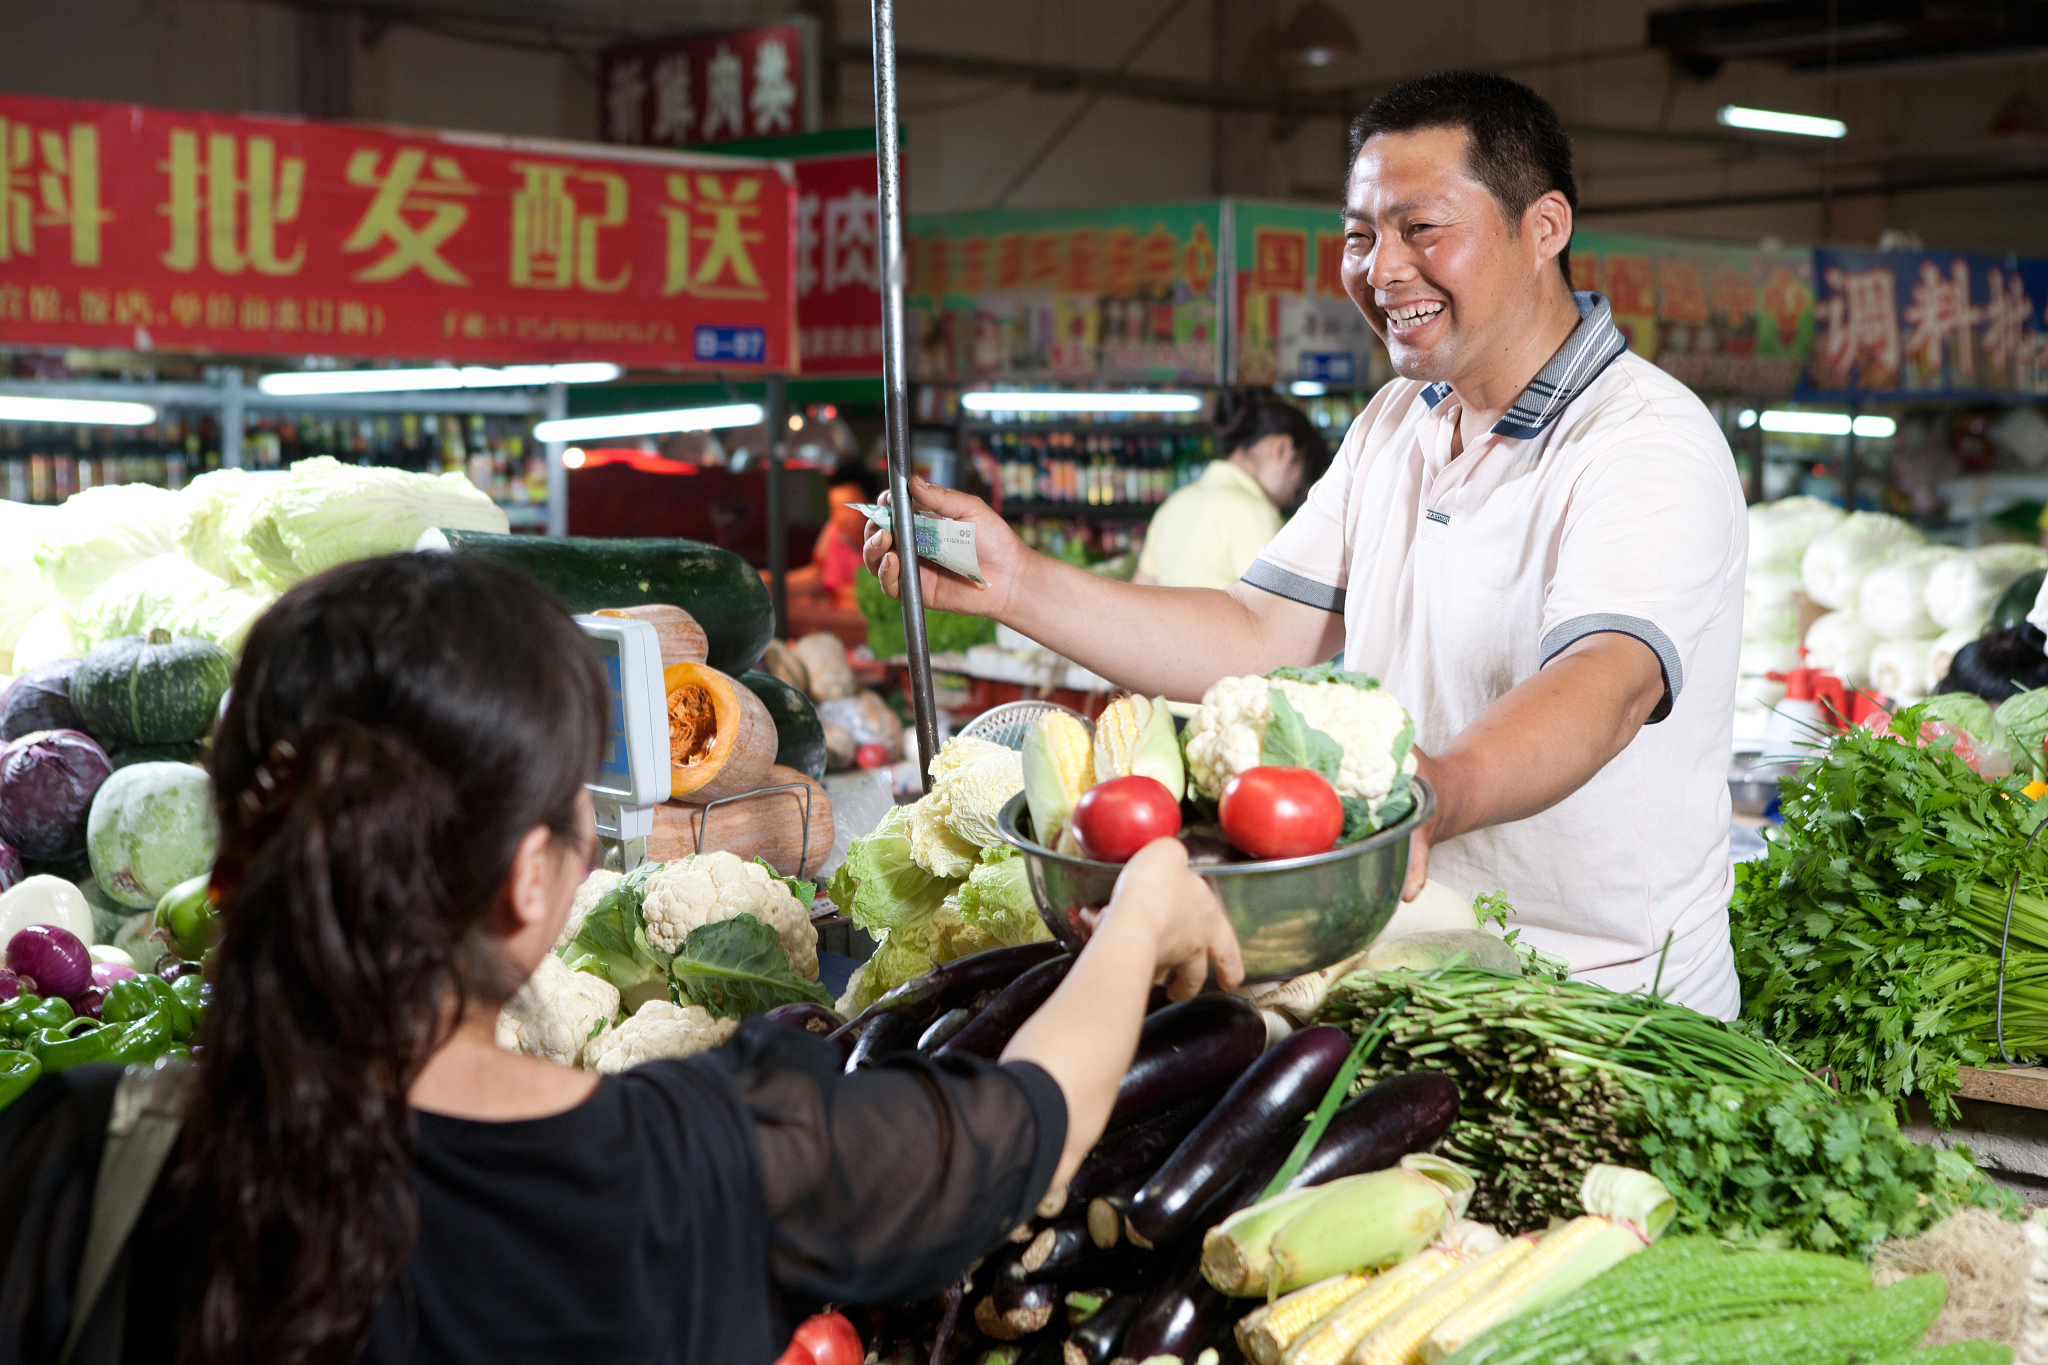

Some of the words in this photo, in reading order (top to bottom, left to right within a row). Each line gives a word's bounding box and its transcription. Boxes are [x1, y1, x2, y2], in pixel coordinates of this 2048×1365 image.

[0, 116, 768, 301] 料批发配送
[959, 529, 971, 538] 50
